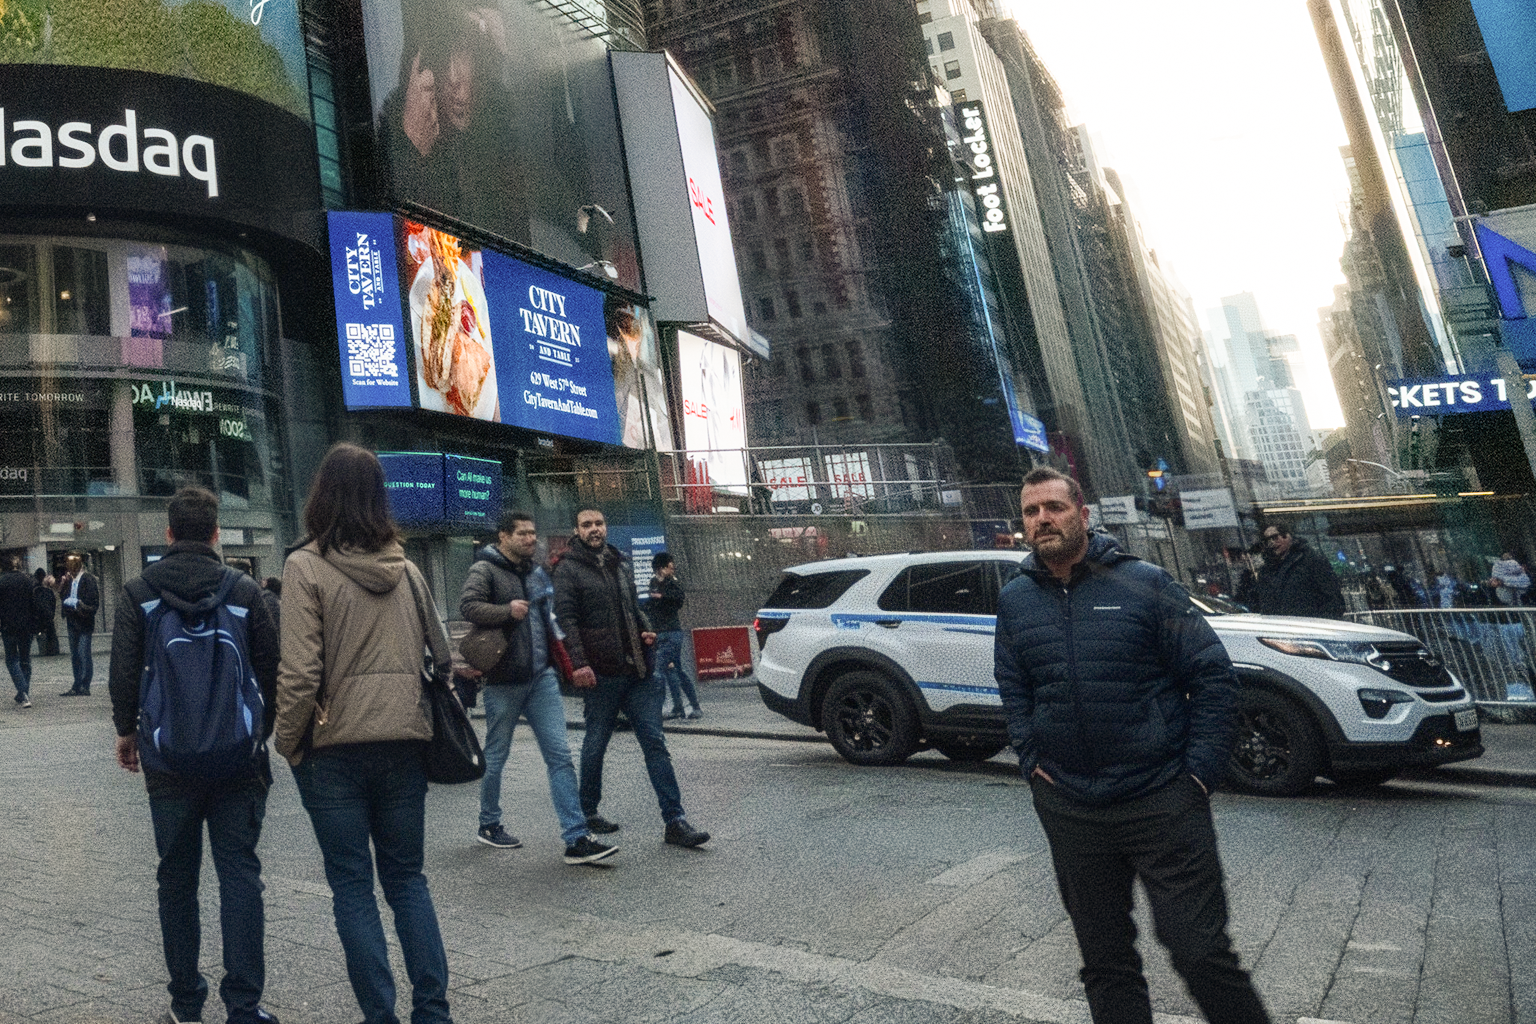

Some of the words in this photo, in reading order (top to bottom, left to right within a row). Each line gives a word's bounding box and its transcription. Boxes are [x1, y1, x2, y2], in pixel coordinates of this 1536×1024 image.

[689, 177, 716, 226] SALE
[976, 183, 1006, 232] Foot
[346, 246, 361, 295] CITY
[356, 232, 375, 311] TAVERN
[528, 285, 567, 317] CITY
[520, 307, 581, 347] TAVERN
[539, 345, 551, 356] AND
[553, 349, 571, 362] TABLE
[352, 378, 366, 386] Scan
[366, 378, 375, 386] for
[375, 378, 399, 386] Website
[530, 371, 541, 385] 629
[541, 373, 559, 390] West
[569, 380, 587, 397] Street
[25, 392, 84, 402] TOMORROW
[524, 390, 598, 419] CityTavernAndTable.com
[684, 399, 708, 419] SALE
[457, 470, 467, 481] Can
[473, 473, 485, 484] make
[485, 476, 492, 484] us
[769, 476, 806, 490] SALE
[834, 472, 867, 485] SALE
[459, 489, 471, 498] more
[471, 489, 490, 500] human?
